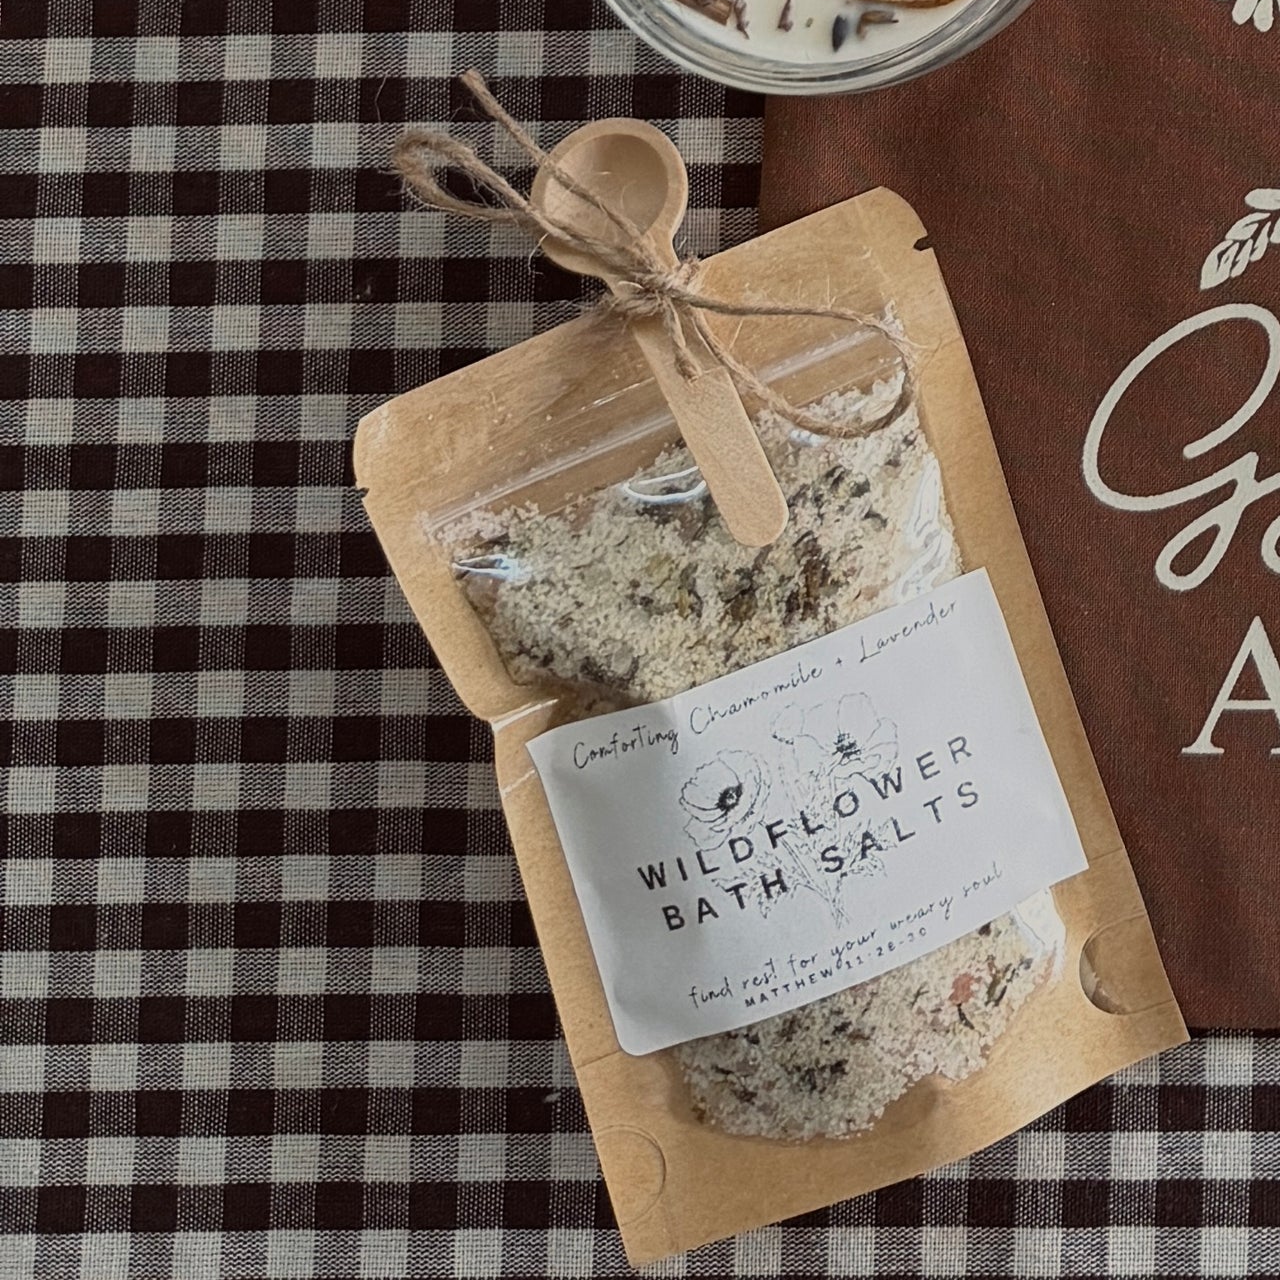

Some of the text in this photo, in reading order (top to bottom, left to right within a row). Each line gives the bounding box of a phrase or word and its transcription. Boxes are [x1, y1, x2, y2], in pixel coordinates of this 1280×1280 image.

[572, 725, 680, 771] Comforting
[689, 662, 823, 735] Chamomile
[858, 599, 958, 664] Lavender
[637, 735, 974, 892] WILDFLOWER
[661, 782, 980, 932] BATH SALTS
[688, 860, 1004, 1009] find rest for your weary soul
[744, 964, 834, 1008] MATTHEW
